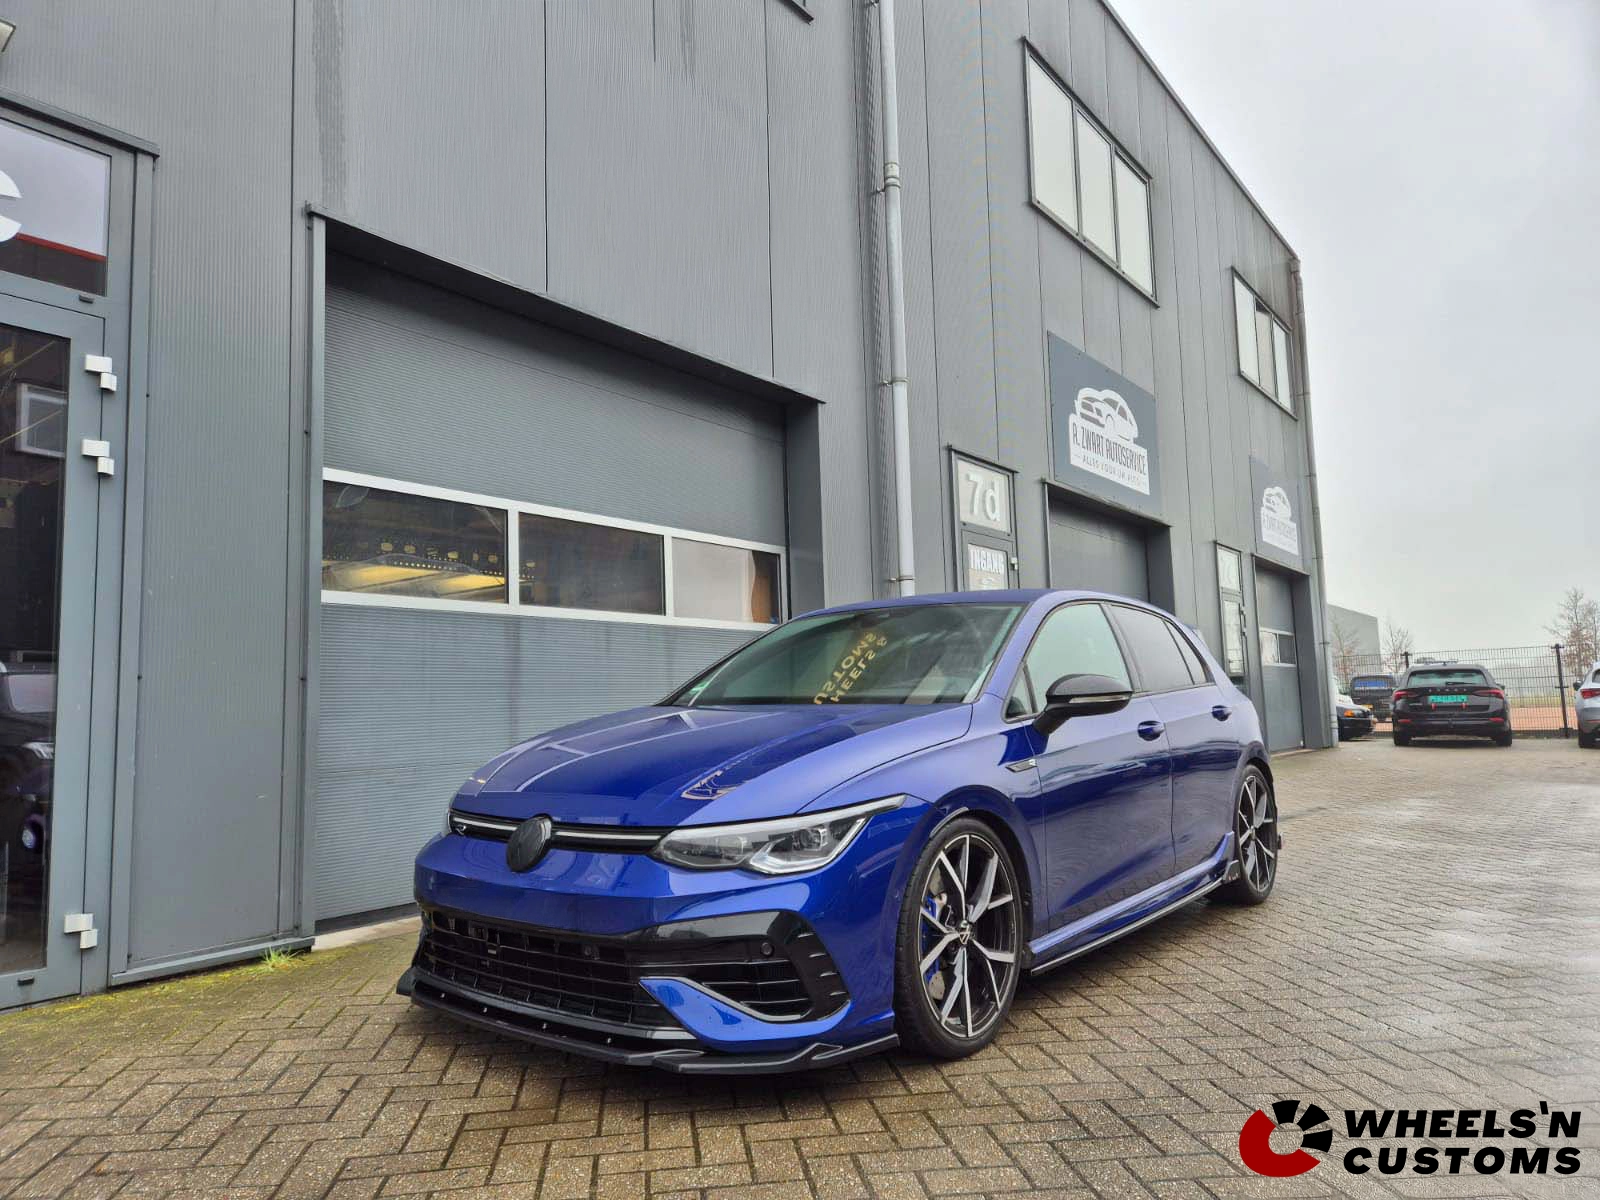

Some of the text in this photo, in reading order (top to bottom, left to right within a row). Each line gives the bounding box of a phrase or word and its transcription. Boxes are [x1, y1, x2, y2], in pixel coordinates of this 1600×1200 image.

[1081, 426, 1104, 457] ZWART
[1105, 438, 1146, 476] AUTOSERVICE
[966, 472, 1001, 521] 7d
